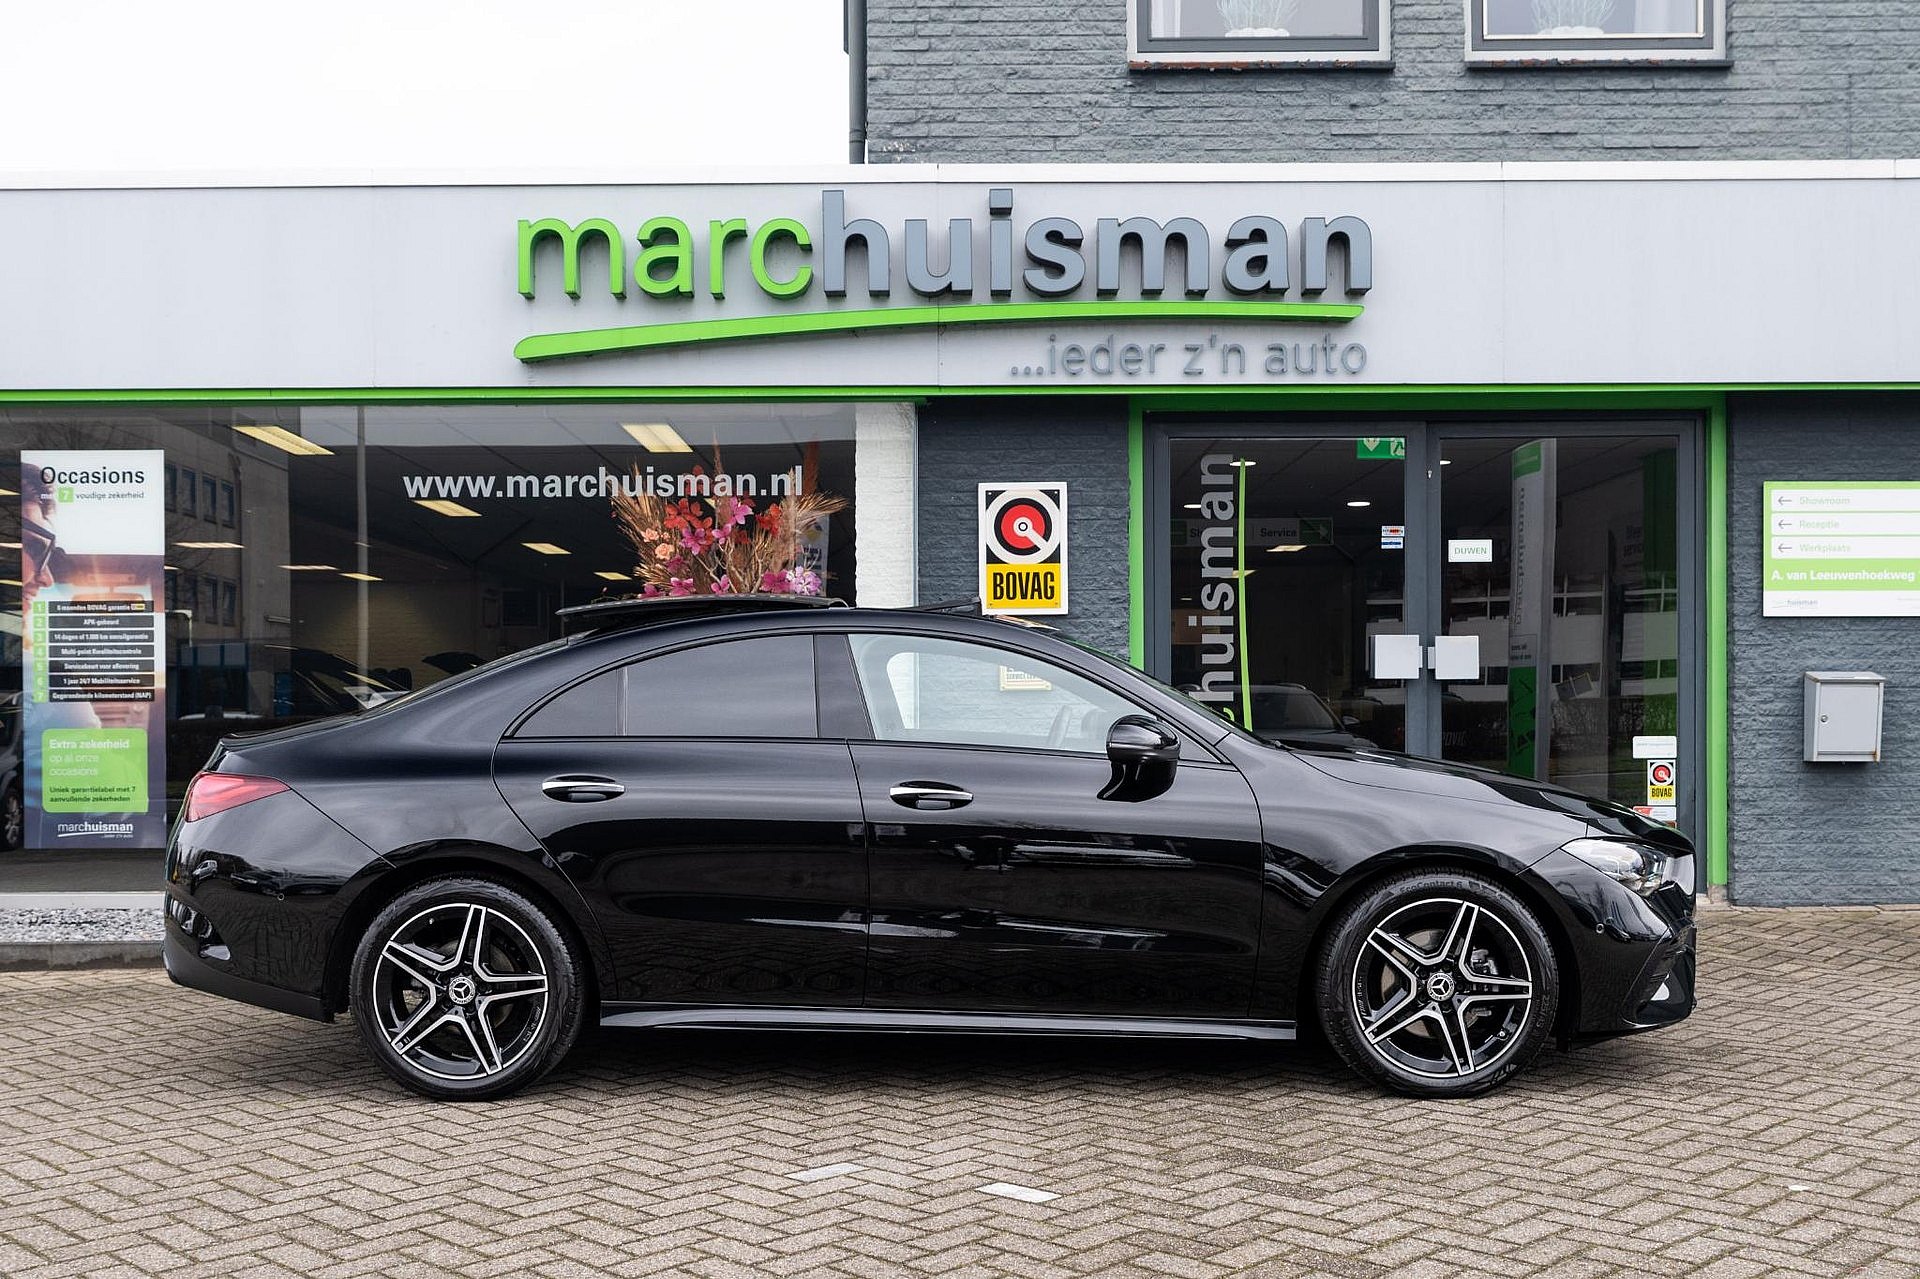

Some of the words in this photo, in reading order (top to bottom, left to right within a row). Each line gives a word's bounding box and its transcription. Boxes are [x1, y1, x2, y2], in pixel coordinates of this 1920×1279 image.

[517, 189, 1373, 299] marchuisman
[1183, 333, 1246, 376] z'n
[1265, 333, 1367, 376] auto
[41, 466, 145, 484] Occasions
[402, 465, 803, 498] www.marchuisman.nl
[63, 490, 69, 500] 7
[76, 491, 106, 501] voudige
[108, 491, 144, 499] zekerheid
[1799, 496, 1850, 505] Showroom
[1799, 520, 1839, 530] Receptie
[1260, 528, 1297, 537] Service
[1454, 547, 1487, 555] DUWEN
[1799, 544, 1851, 554] Werkplaats
[1771, 569, 1783, 580] A.
[1786, 571, 1807, 580] van
[1810, 569, 1915, 582] Leeuwenhoekweg
[993, 571, 1055, 601] BOVAG
[49, 739, 76, 749] Extra
[79, 739, 130, 749] zekerheid
[71, 786, 115, 794] garantielabel
[1651, 788, 1672, 798] BOVAG
[57, 821, 134, 832] marchuisman
[1400, 881, 1454, 893] EcoContact
